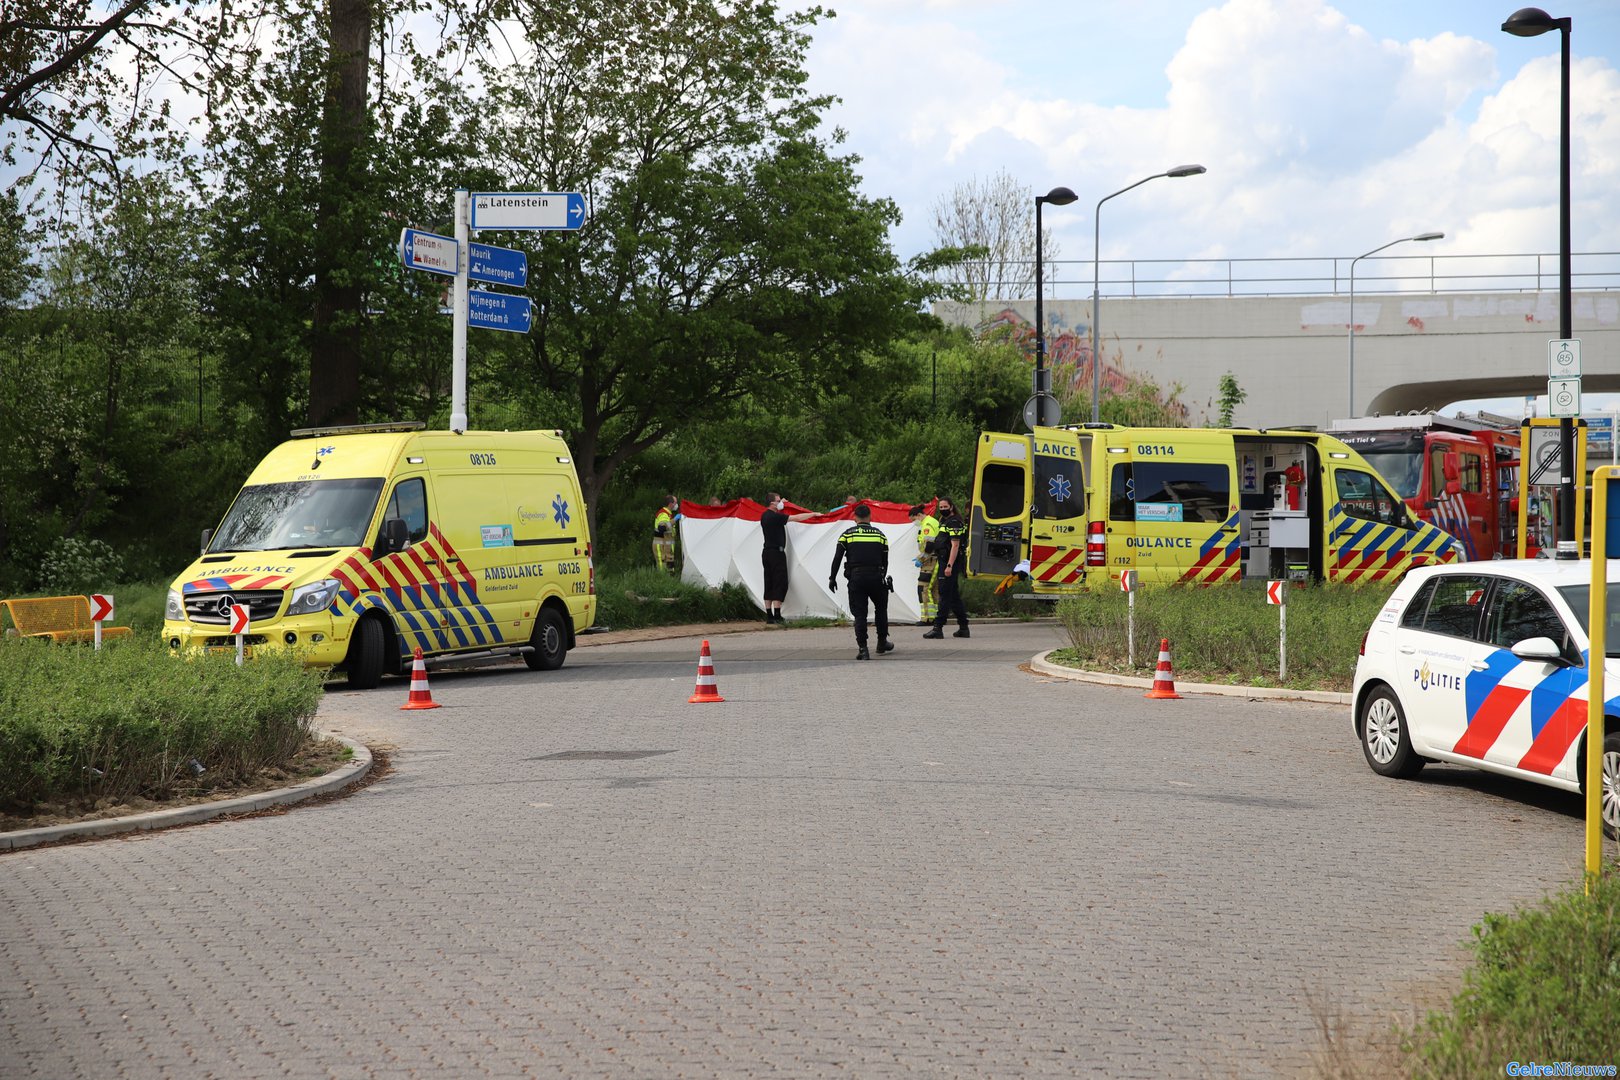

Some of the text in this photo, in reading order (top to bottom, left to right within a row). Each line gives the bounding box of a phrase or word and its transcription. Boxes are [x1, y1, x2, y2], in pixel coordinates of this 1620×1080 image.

[490, 197, 549, 208] Latenstein
[413, 235, 437, 249] Centrum
[470, 247, 492, 260] Maurik
[422, 254, 441, 267] Wamel
[481, 264, 515, 280] Amerongen
[470, 294, 500, 309] Nijmegen
[470, 309, 503, 324] Rotterdam
[1559, 354, 1571, 362] 85
[1559, 395, 1570, 403] 52
[1034, 442, 1077, 457] LANCE
[1137, 445, 1175, 456] 08114
[470, 453, 497, 466] 08126
[1055, 525, 1068, 533] 112
[1118, 557, 1131, 565] 112
[197, 566, 296, 578] AMBULANCE
[484, 564, 544, 580] AMBULANCE
[558, 562, 581, 575] 08126
[575, 582, 586, 593] 112
[1414, 668, 1461, 691] POLITIE
